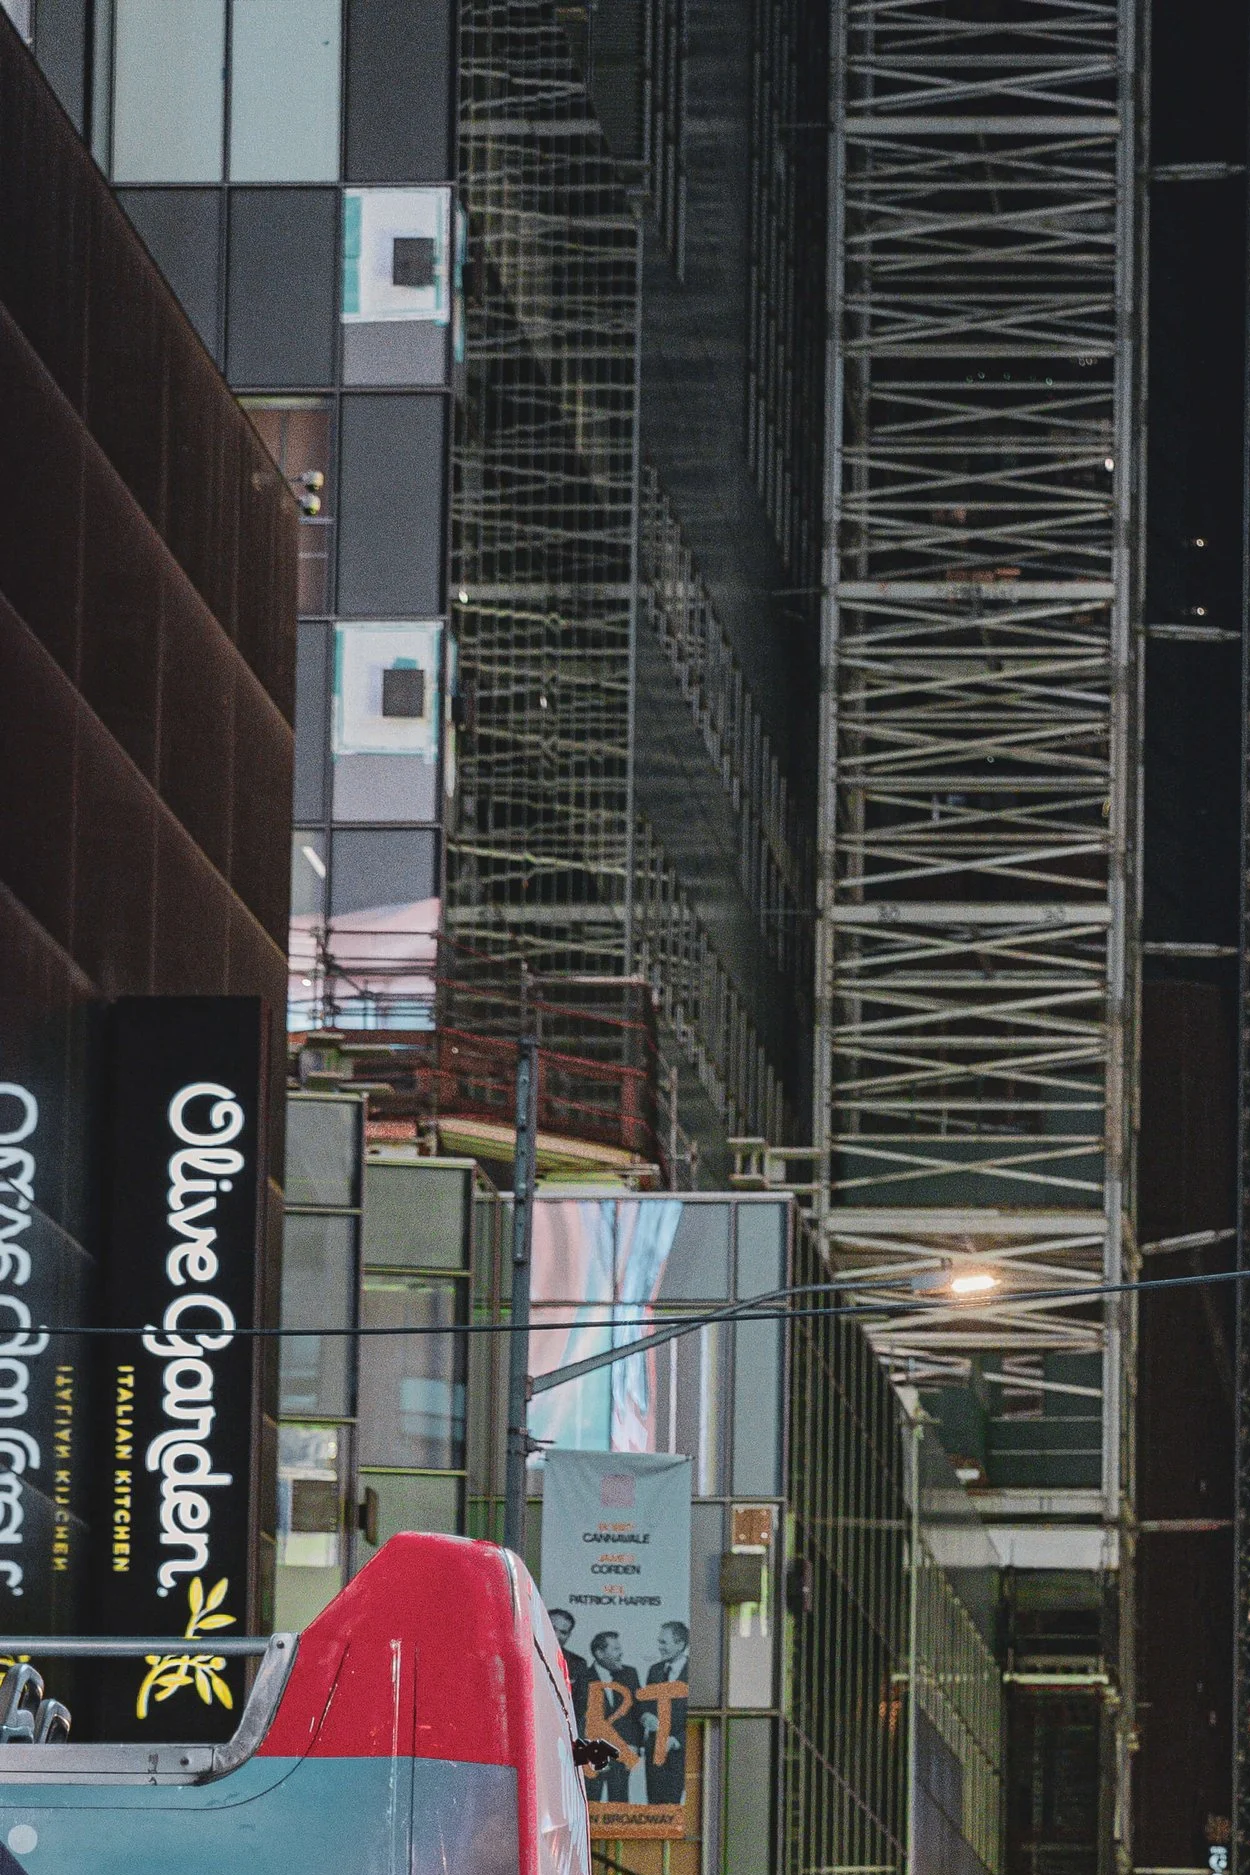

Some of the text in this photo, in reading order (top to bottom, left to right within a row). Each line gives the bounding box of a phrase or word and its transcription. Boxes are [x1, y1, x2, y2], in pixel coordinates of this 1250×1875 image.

[142, 1082, 246, 1590] Olive Garden
[111, 1364, 136, 1572] ITALIAN KITCHEN
[582, 1532, 651, 1545] CANNAVALE
[590, 1564, 642, 1575] CORDEN
[569, 1594, 662, 1607] PATRICK HARRIS
[584, 1679, 689, 1773] RT
[604, 1813, 675, 1825] BROADWAY
